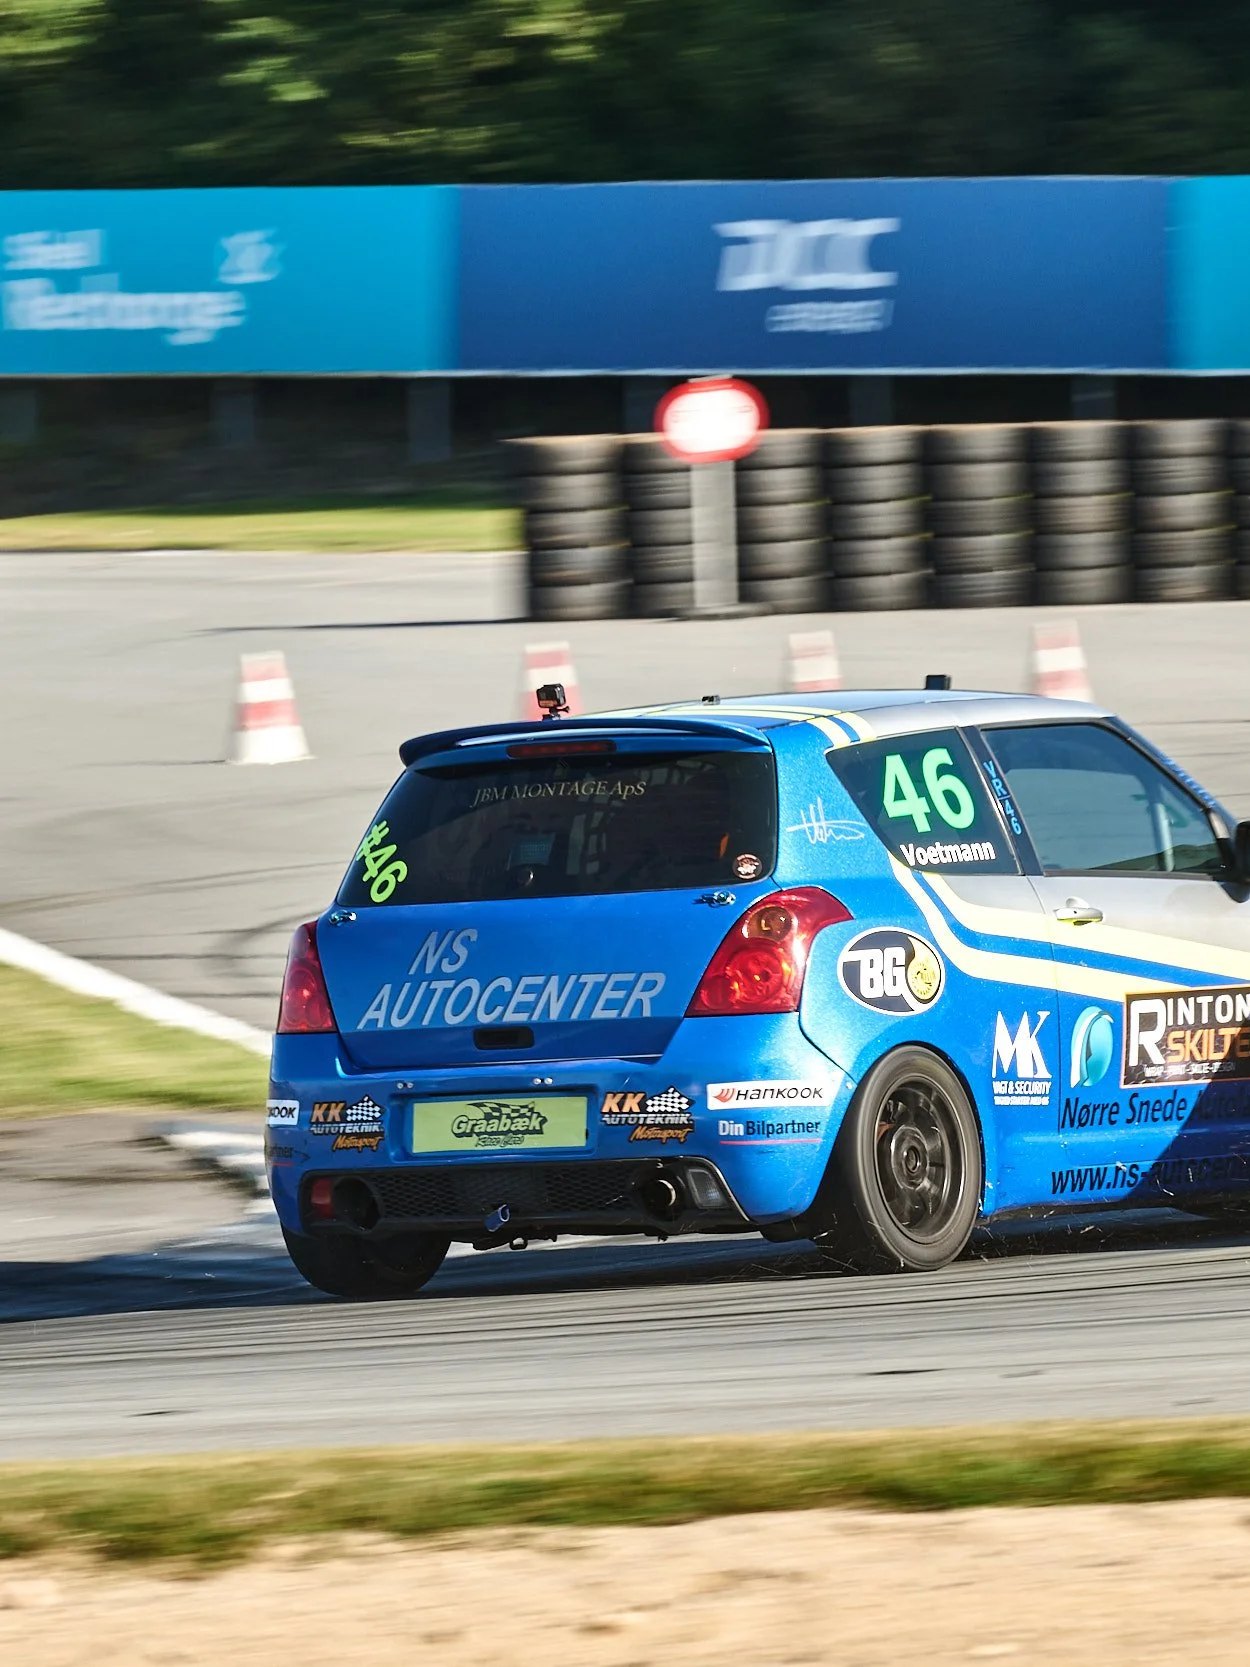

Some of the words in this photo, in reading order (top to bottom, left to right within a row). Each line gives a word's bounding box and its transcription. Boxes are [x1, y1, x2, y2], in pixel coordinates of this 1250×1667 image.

[469, 786, 509, 808] JBM
[510, 781, 608, 800] MONTAGE
[610, 780, 647, 800] ApS
[883, 747, 975, 833] 46
[355, 820, 408, 903] #46
[900, 842, 996, 866] Voetmann
[408, 928, 478, 975] NS
[859, 946, 906, 999] BG
[356, 972, 667, 1030] AUTOCENTER
[992, 1010, 1052, 1078] MK
[311, 1102, 345, 1122] KK
[602, 1093, 645, 1113] KK
[1060, 1097, 1120, 1129] Nørre
[1126, 1089, 1188, 1124] Snede
[451, 1112, 547, 1137] Graabæk
[718, 1120, 744, 1136] Din
[746, 1119, 821, 1138] Bilpartner
